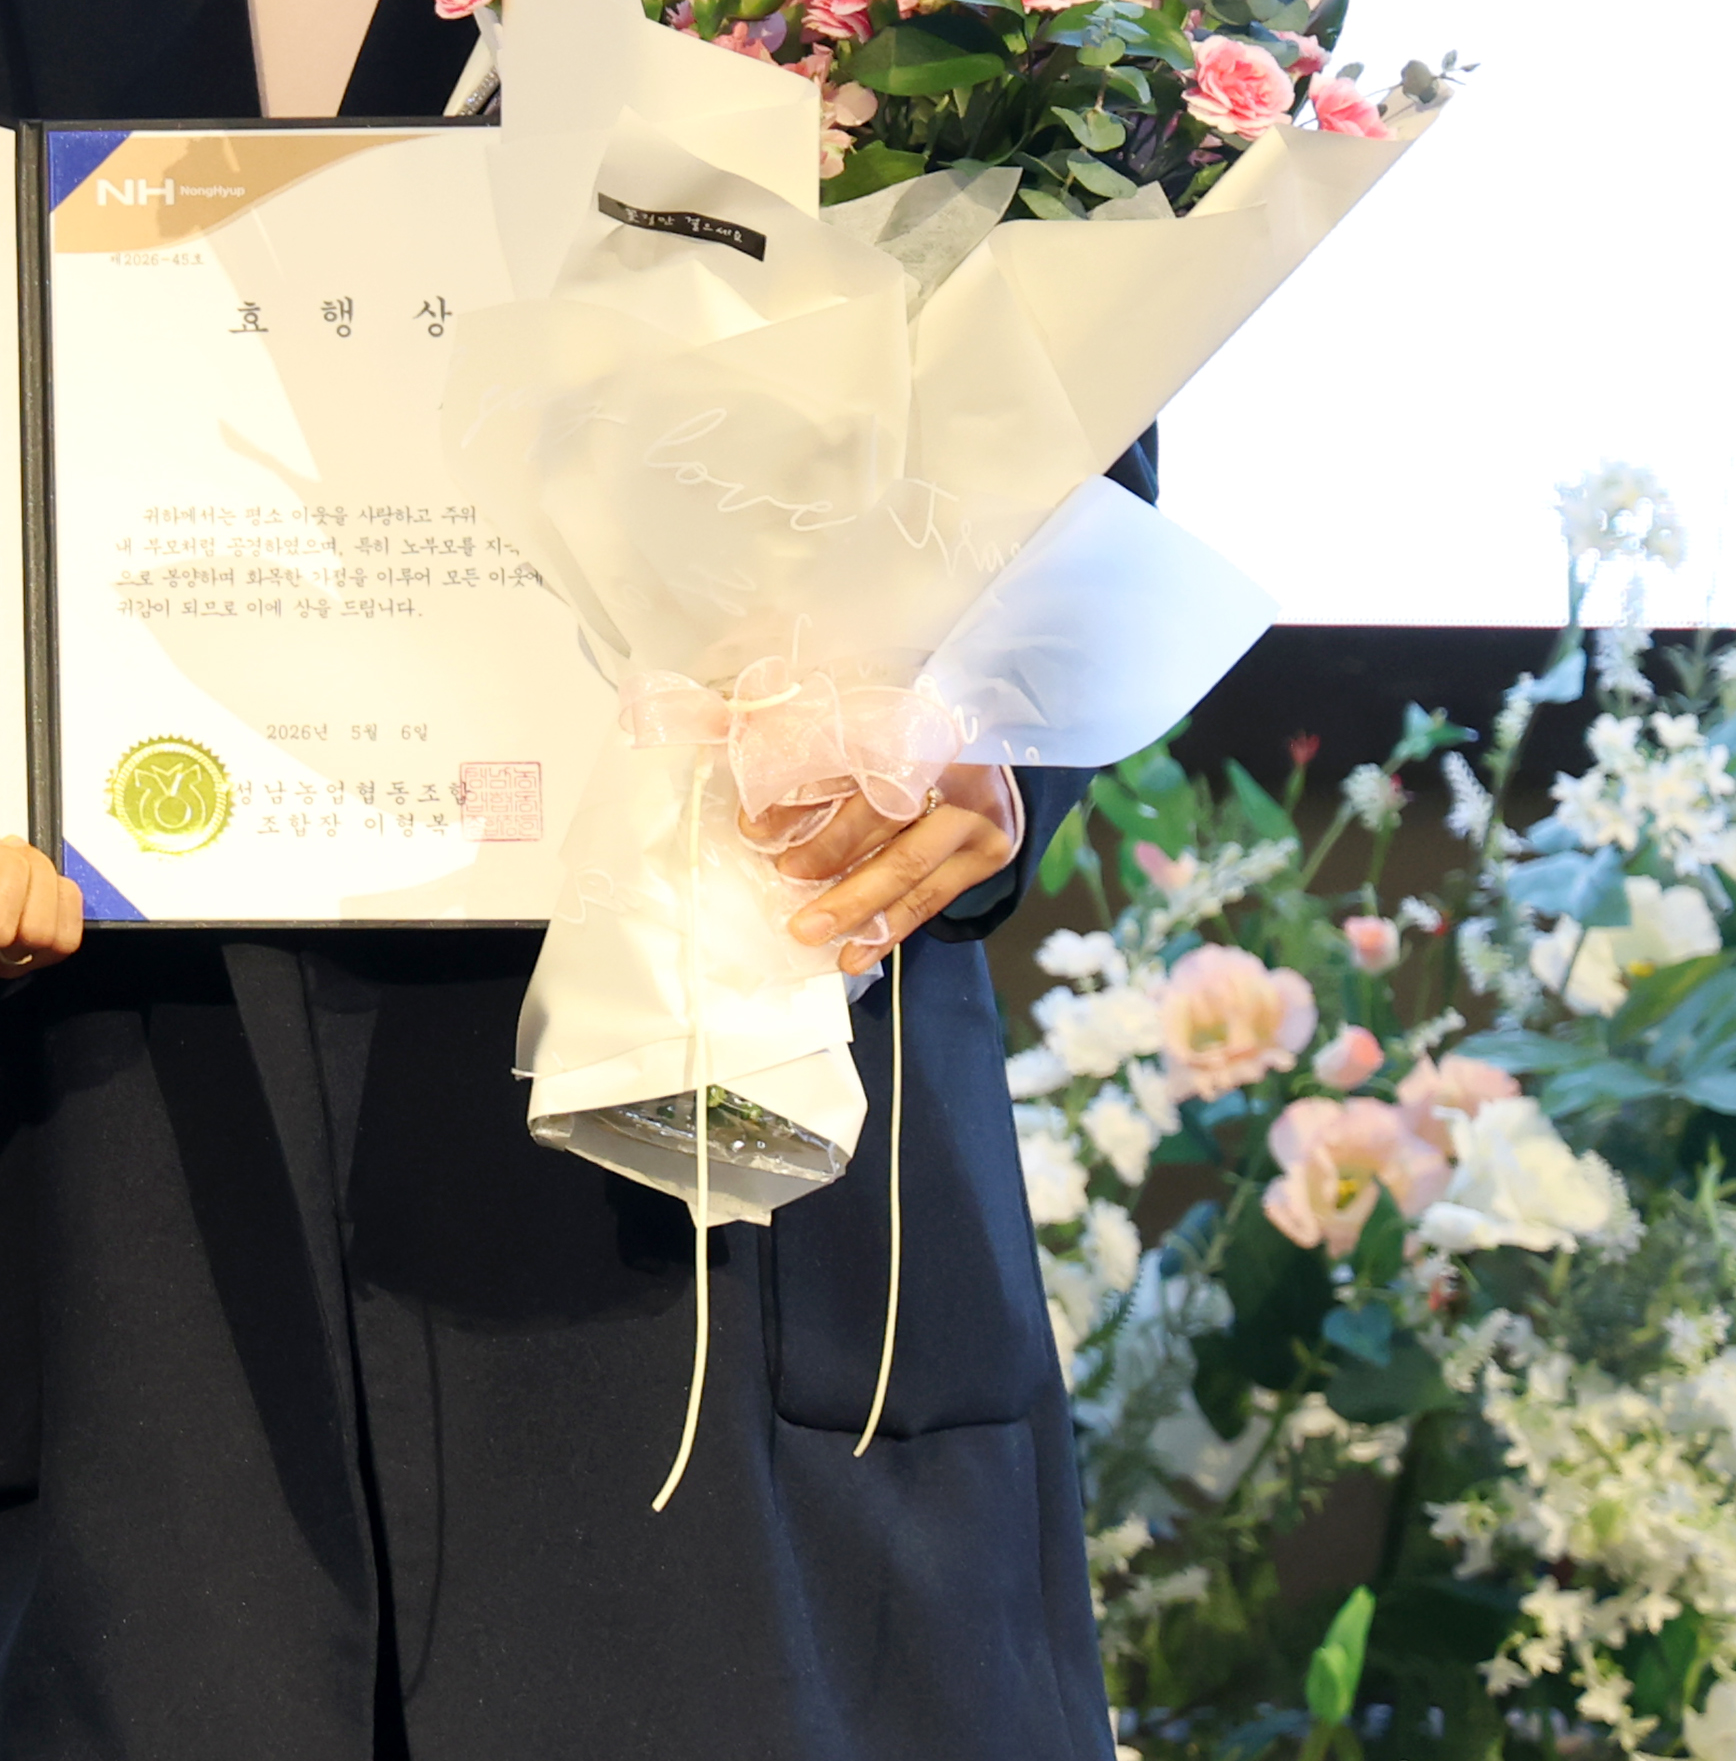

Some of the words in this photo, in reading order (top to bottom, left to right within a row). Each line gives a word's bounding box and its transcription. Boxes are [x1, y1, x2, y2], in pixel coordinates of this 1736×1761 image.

[96, 178, 175, 206] NH
[179, 185, 246, 199] NongHyup
[244, 505, 283, 527] 평소
[292, 505, 348, 527] 이웃을
[358, 505, 432, 527] 사랑하고
[441, 505, 476, 526] 주위
[116, 536, 132, 556] 내
[143, 536, 216, 558] 부모처럼
[354, 536, 389, 557] 특히
[401, 536, 476, 557] 노부모를
[116, 569, 154, 587] 으로
[162, 567, 235, 589] 봉양하며
[246, 567, 303, 588] 화목한
[313, 567, 368, 588] 가정을
[377, 567, 431, 587] 이루어
[442, 567, 481, 586] 모든
[489, 567, 543, 588] 이웃에
[117, 598, 170, 619] 귀감이
[181, 598, 238, 618] 되므로
[247, 598, 282, 618] 이에
[296, 598, 332, 619] 상을
[341, 598, 423, 619] 드립니다.
[266, 723, 328, 741] 2026년
[351, 723, 378, 741] 5월
[401, 723, 428, 741] 6일
